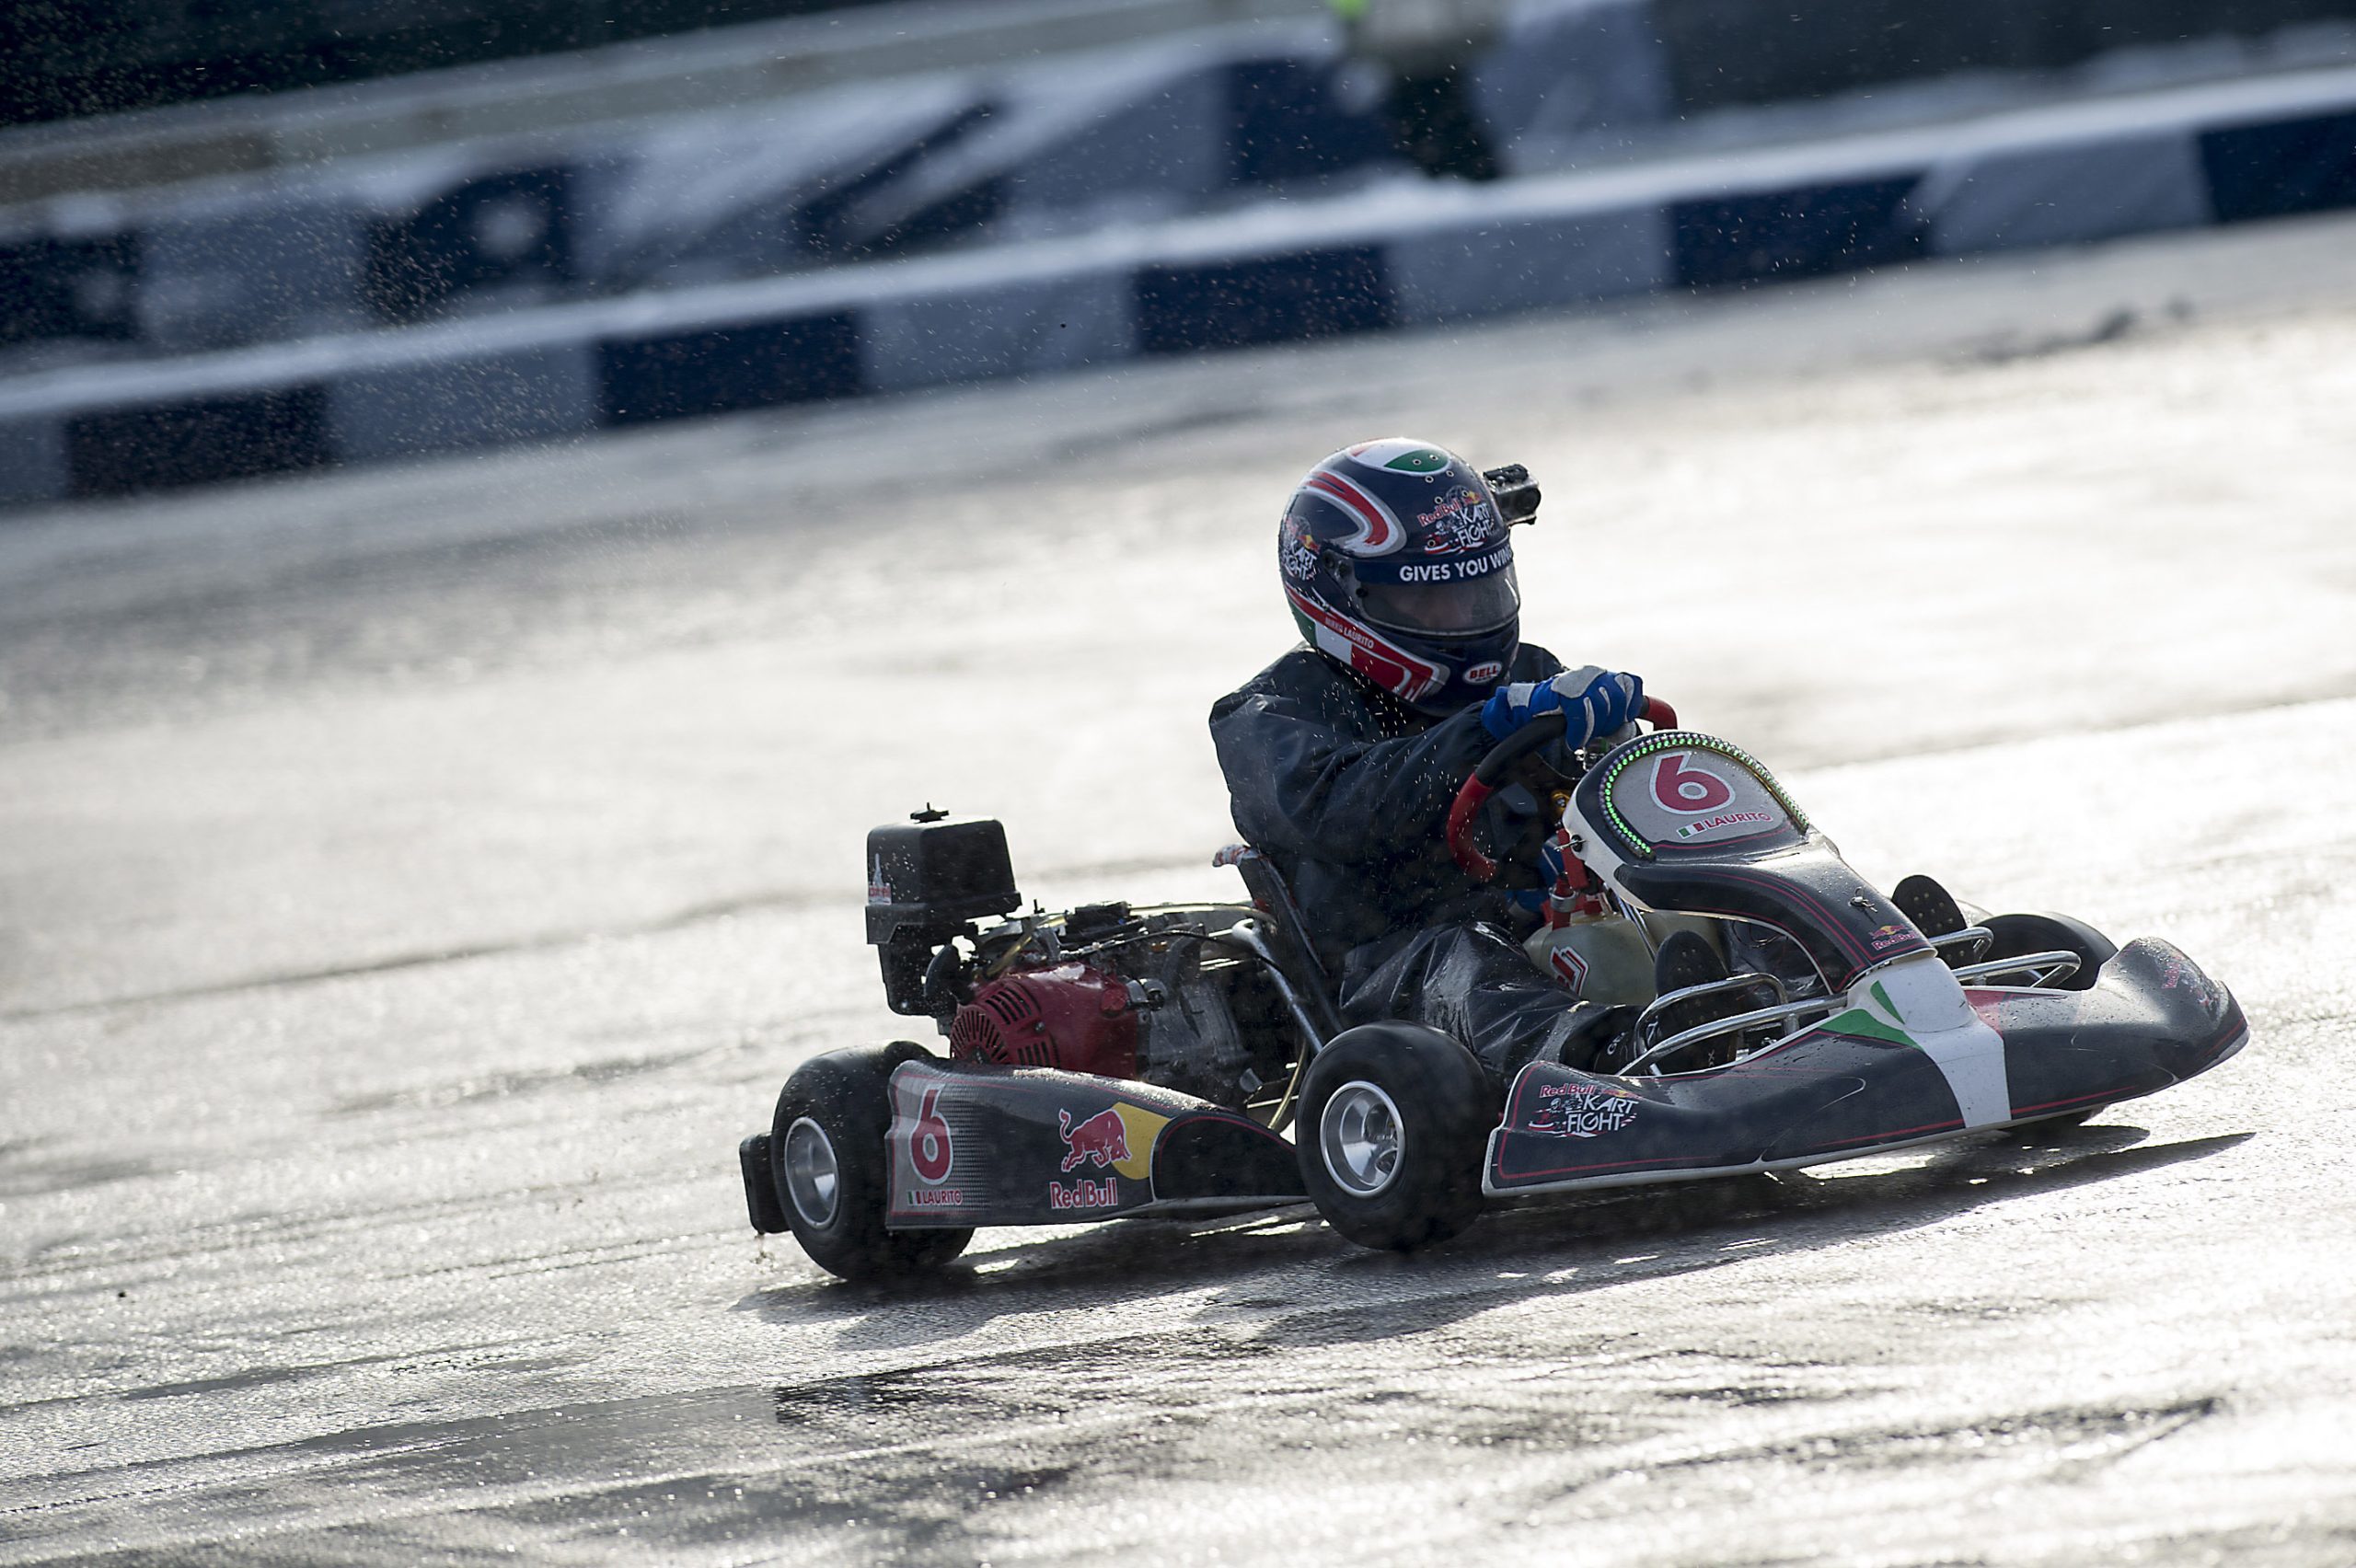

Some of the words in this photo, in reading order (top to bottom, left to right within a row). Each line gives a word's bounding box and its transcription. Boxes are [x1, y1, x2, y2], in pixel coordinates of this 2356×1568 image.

[1418, 505, 1443, 527] Red
[1441, 497, 1461, 516] Bull
[1460, 502, 1490, 525] KART
[1457, 519, 1492, 547] FIGHT
[1400, 564, 1451, 582] GIVES
[1455, 556, 1489, 578] YOU
[1470, 664, 1497, 679] BELL
[1649, 751, 1737, 814] 6
[1704, 813, 1773, 828] LAURITO
[1871, 934, 1898, 951] Red
[1540, 1083, 1568, 1098] Red
[1567, 1083, 1598, 1095] Bull
[1583, 1094, 1639, 1114] KART
[1566, 1113, 1624, 1133] FIGHT
[909, 1084, 953, 1185] 6
[922, 1189, 963, 1205] LAURITO
[1049, 1179, 1084, 1209] Red
[1084, 1177, 1118, 1207] Bull
